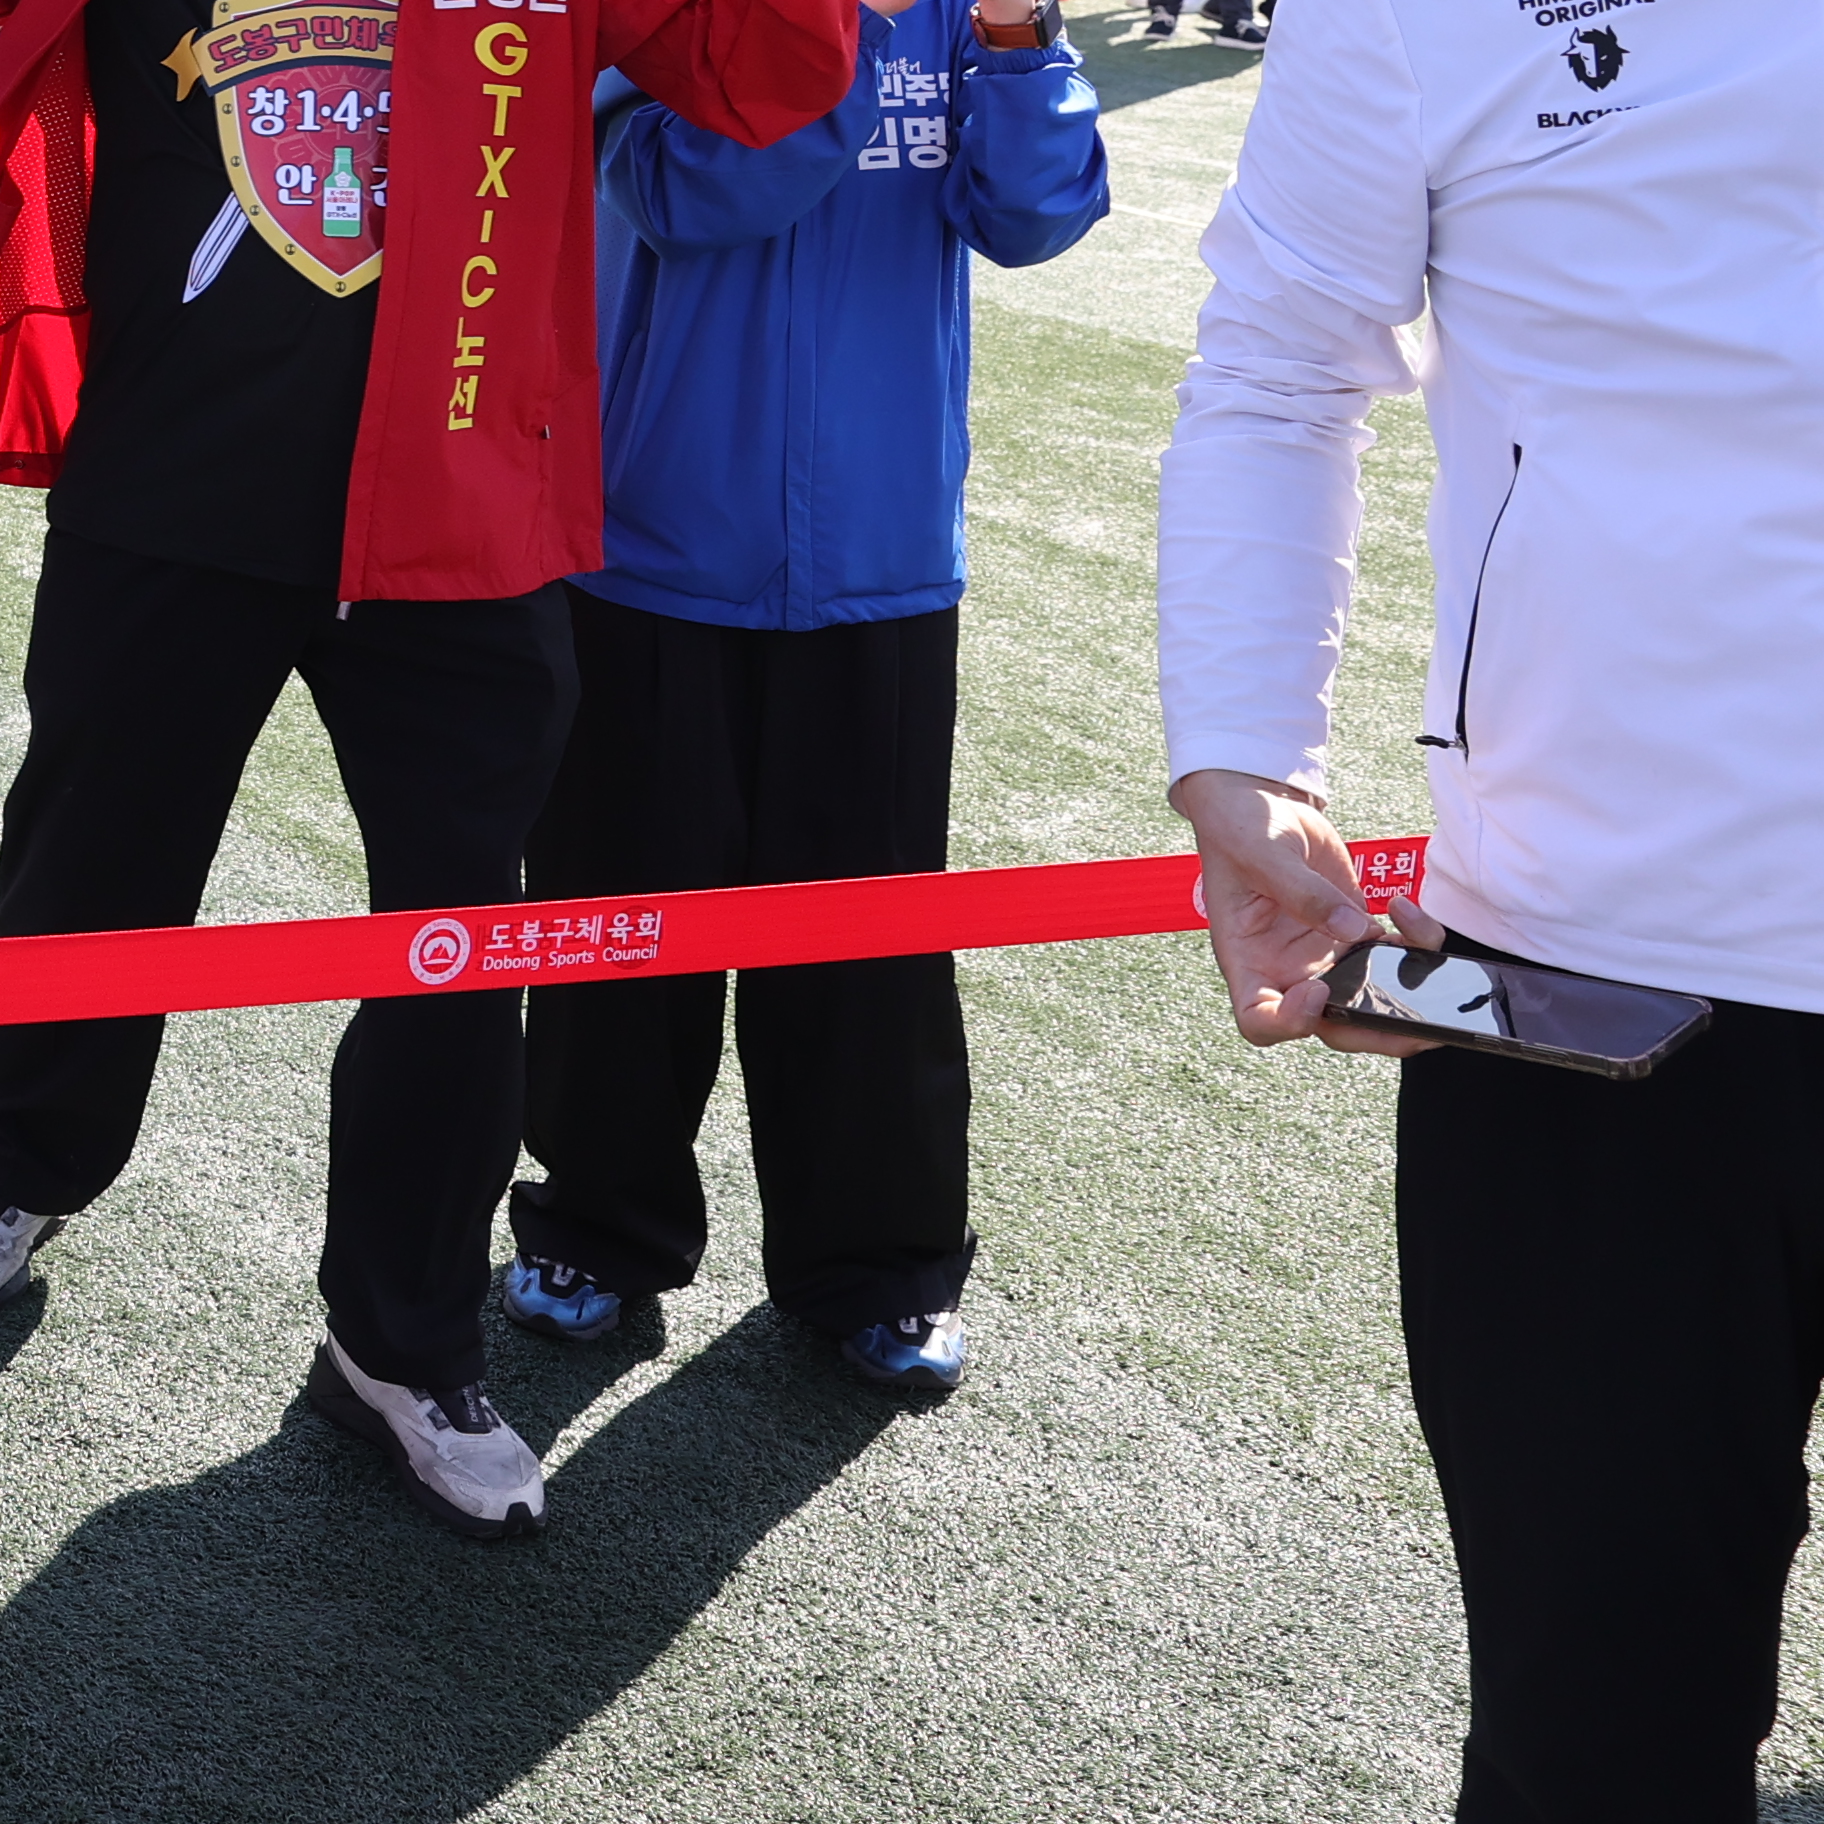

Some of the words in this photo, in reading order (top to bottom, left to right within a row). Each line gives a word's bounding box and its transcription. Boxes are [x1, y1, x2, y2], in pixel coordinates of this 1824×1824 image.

[885, 57, 921, 75] 더불어
[1537, 105, 1642, 128] BLACK
[858, 115, 953, 170] 김명
[275, 164, 317, 207] 안
[1363, 881, 1413, 899] Council
[485, 910, 663, 953] 도봉구체육회
[482, 955, 540, 972] Dobong
[548, 950, 595, 969] Sports
[602, 944, 658, 963] Council
